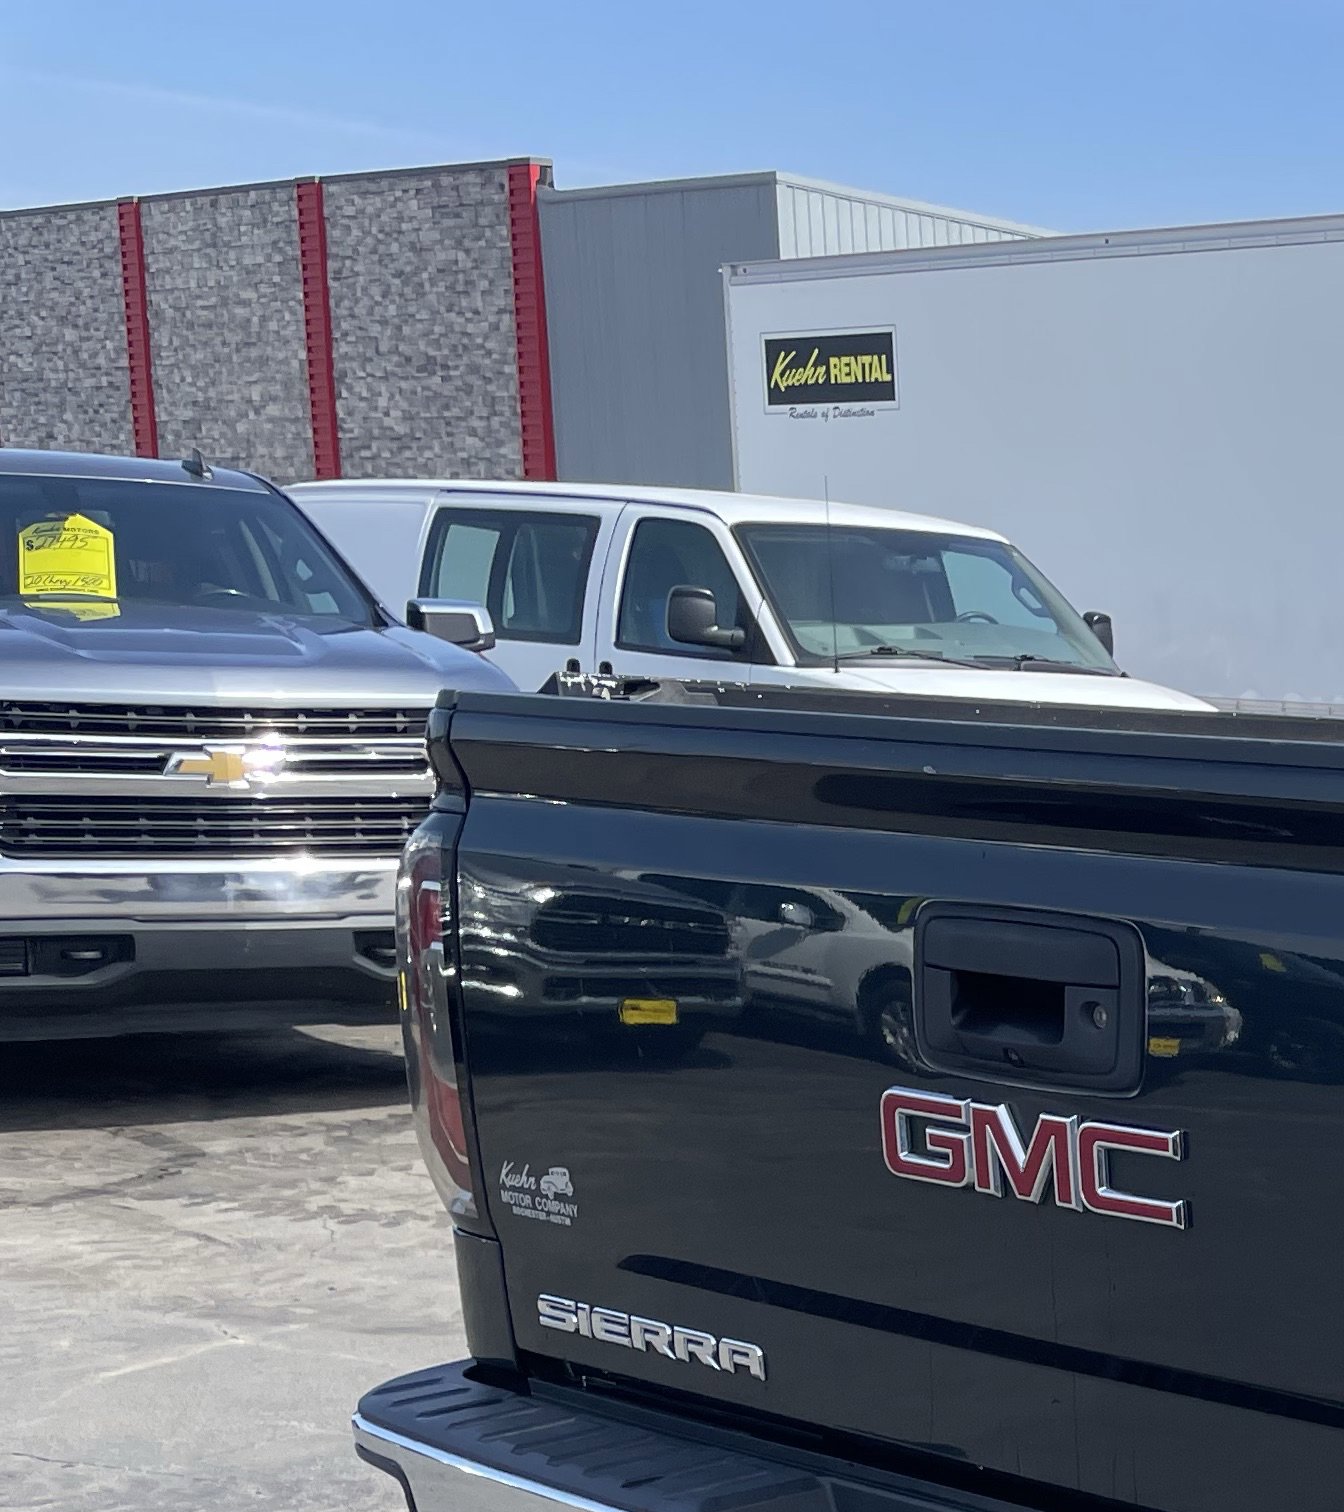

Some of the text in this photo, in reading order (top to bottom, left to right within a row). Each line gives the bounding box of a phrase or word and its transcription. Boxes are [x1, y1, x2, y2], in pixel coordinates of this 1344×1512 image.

[770, 347, 892, 393] Kuehn RENTAL
[788, 406, 818, 420] Rentals
[832, 406, 876, 420] Distinction
[500, 1160, 537, 1190] Kuehn
[880, 1085, 1187, 1230] GMC
[500, 1189, 578, 1218] MOTOR COMPANY
[537, 1293, 767, 1382] SIERRA
